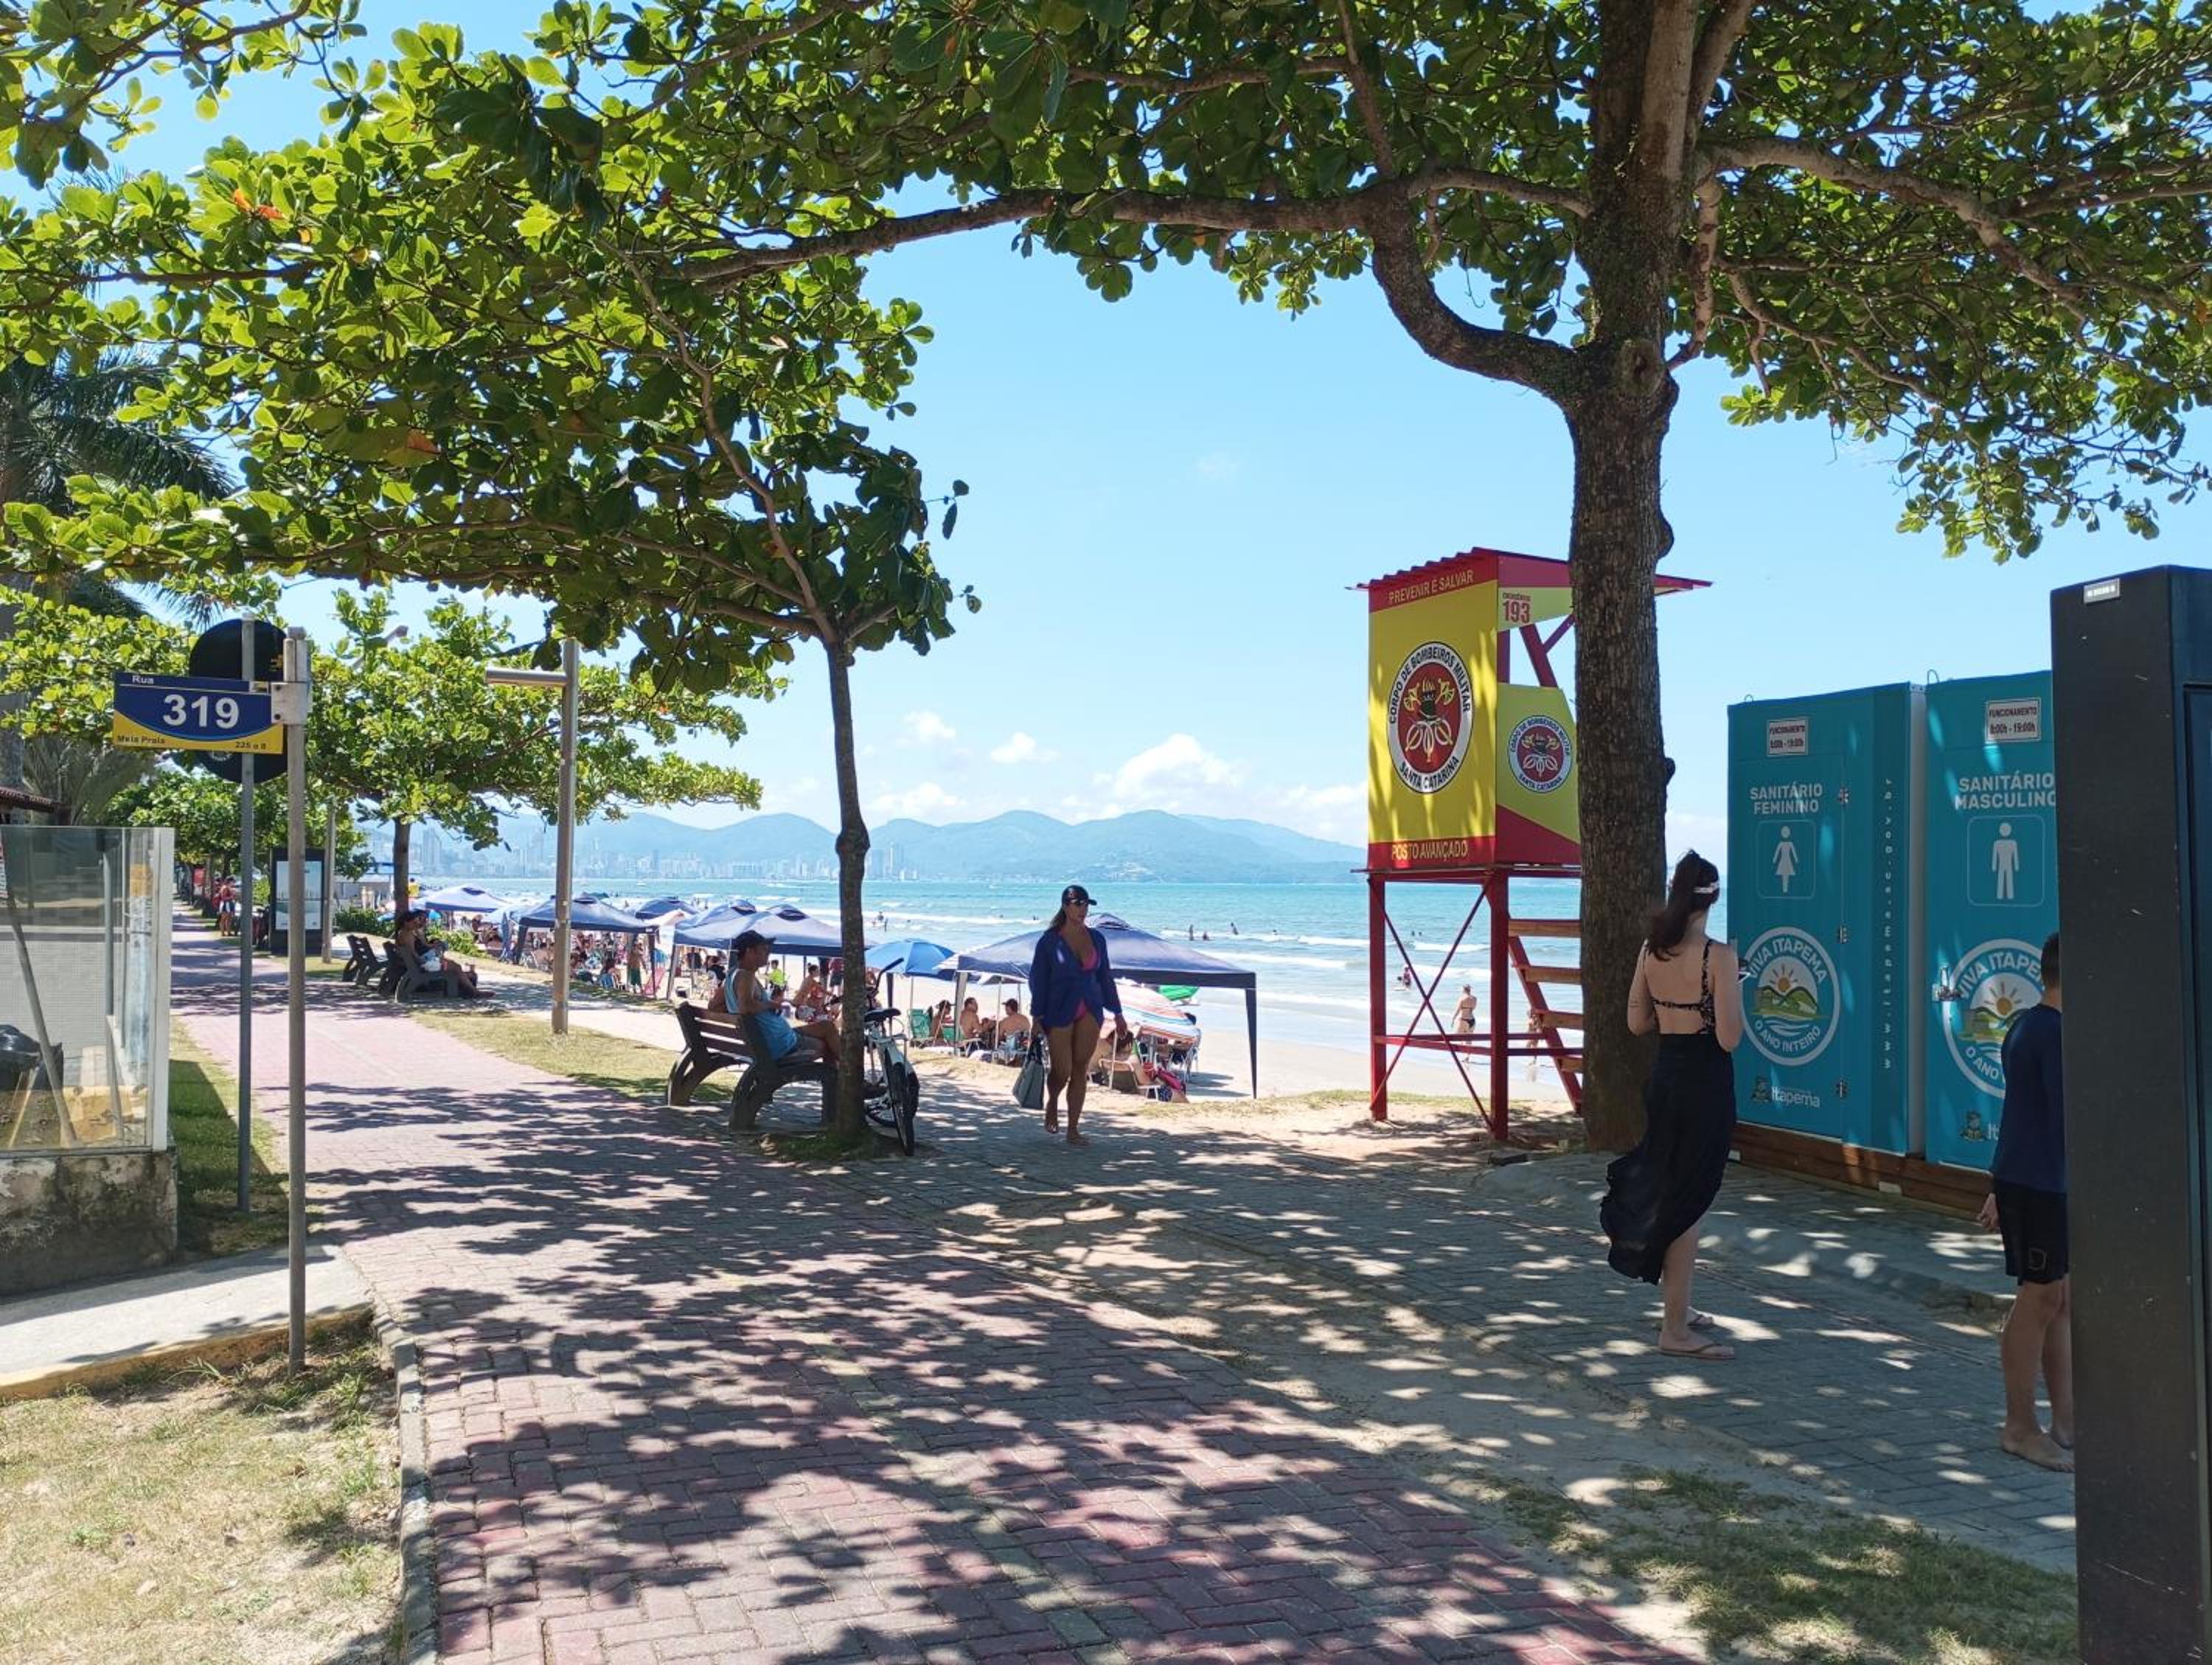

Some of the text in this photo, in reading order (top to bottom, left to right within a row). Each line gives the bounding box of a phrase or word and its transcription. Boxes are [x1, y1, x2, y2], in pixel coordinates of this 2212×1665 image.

[1388, 569, 1474, 605] PREVENIR E SALVAR
[1502, 600, 1531, 623] 193
[132, 675, 154, 685] Rua
[1389, 646, 1471, 724] CORPO DE BOMBEIROS MILITAR
[163, 694, 240, 729] 319
[1989, 706, 2037, 718] FUNCIONAMENTO
[1400, 755, 1460, 789] SANTA CATARINA
[1958, 770, 2054, 792] SANITÁRIO
[1750, 781, 1823, 800] SANITÁRIO
[1754, 799, 1820, 815] FEMININO
[1391, 840, 1468, 861] POSTO AVANÇADO
[1750, 937, 1829, 984] VIVA ITAPEMA
[1958, 952, 2044, 999] VIVA ITAPE
[1755, 1019, 1821, 1052] O ANO INTEIRO
[1965, 1046, 1999, 1080] O ANO
[1772, 1085, 1820, 1108] Itapema
